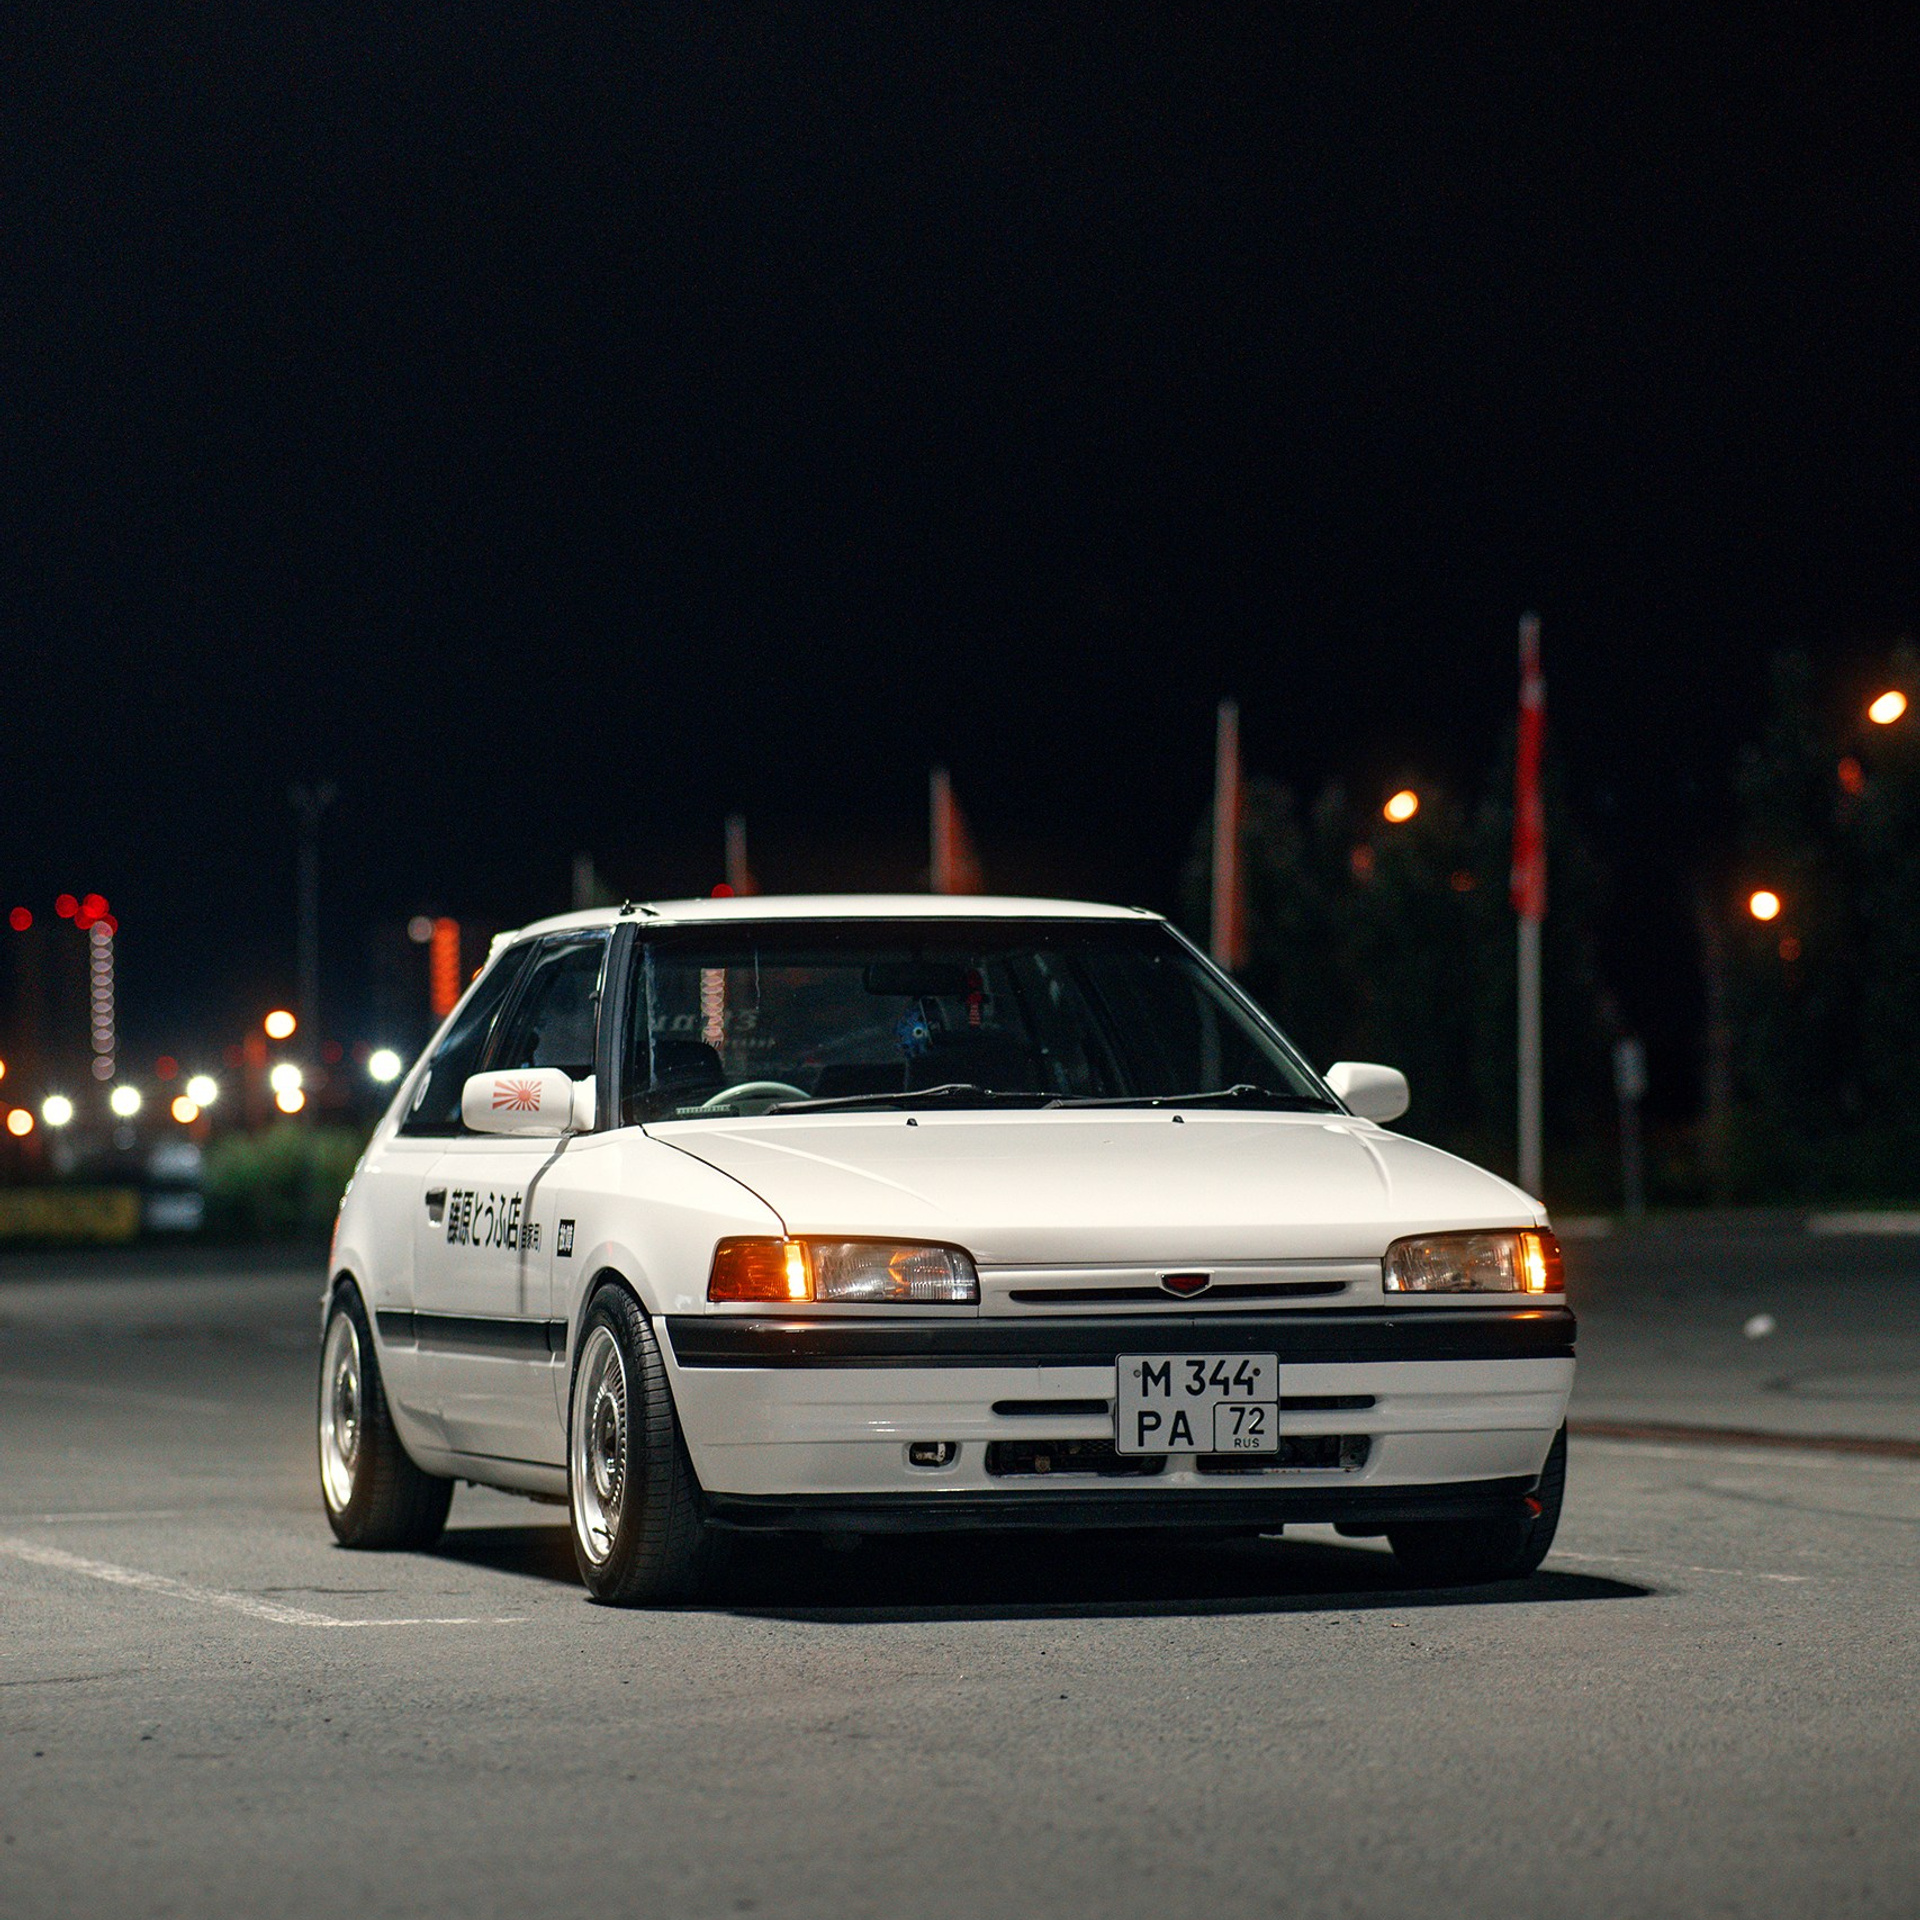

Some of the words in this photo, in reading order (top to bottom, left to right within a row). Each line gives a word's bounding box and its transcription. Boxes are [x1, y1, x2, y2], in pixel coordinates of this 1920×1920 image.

[1142, 1360, 1171, 1397] M
[1185, 1359, 1254, 1396] 344
[1137, 1410, 1194, 1447] PA
[1229, 1407, 1265, 1435] 72
[1234, 1438, 1260, 1448] RUS
